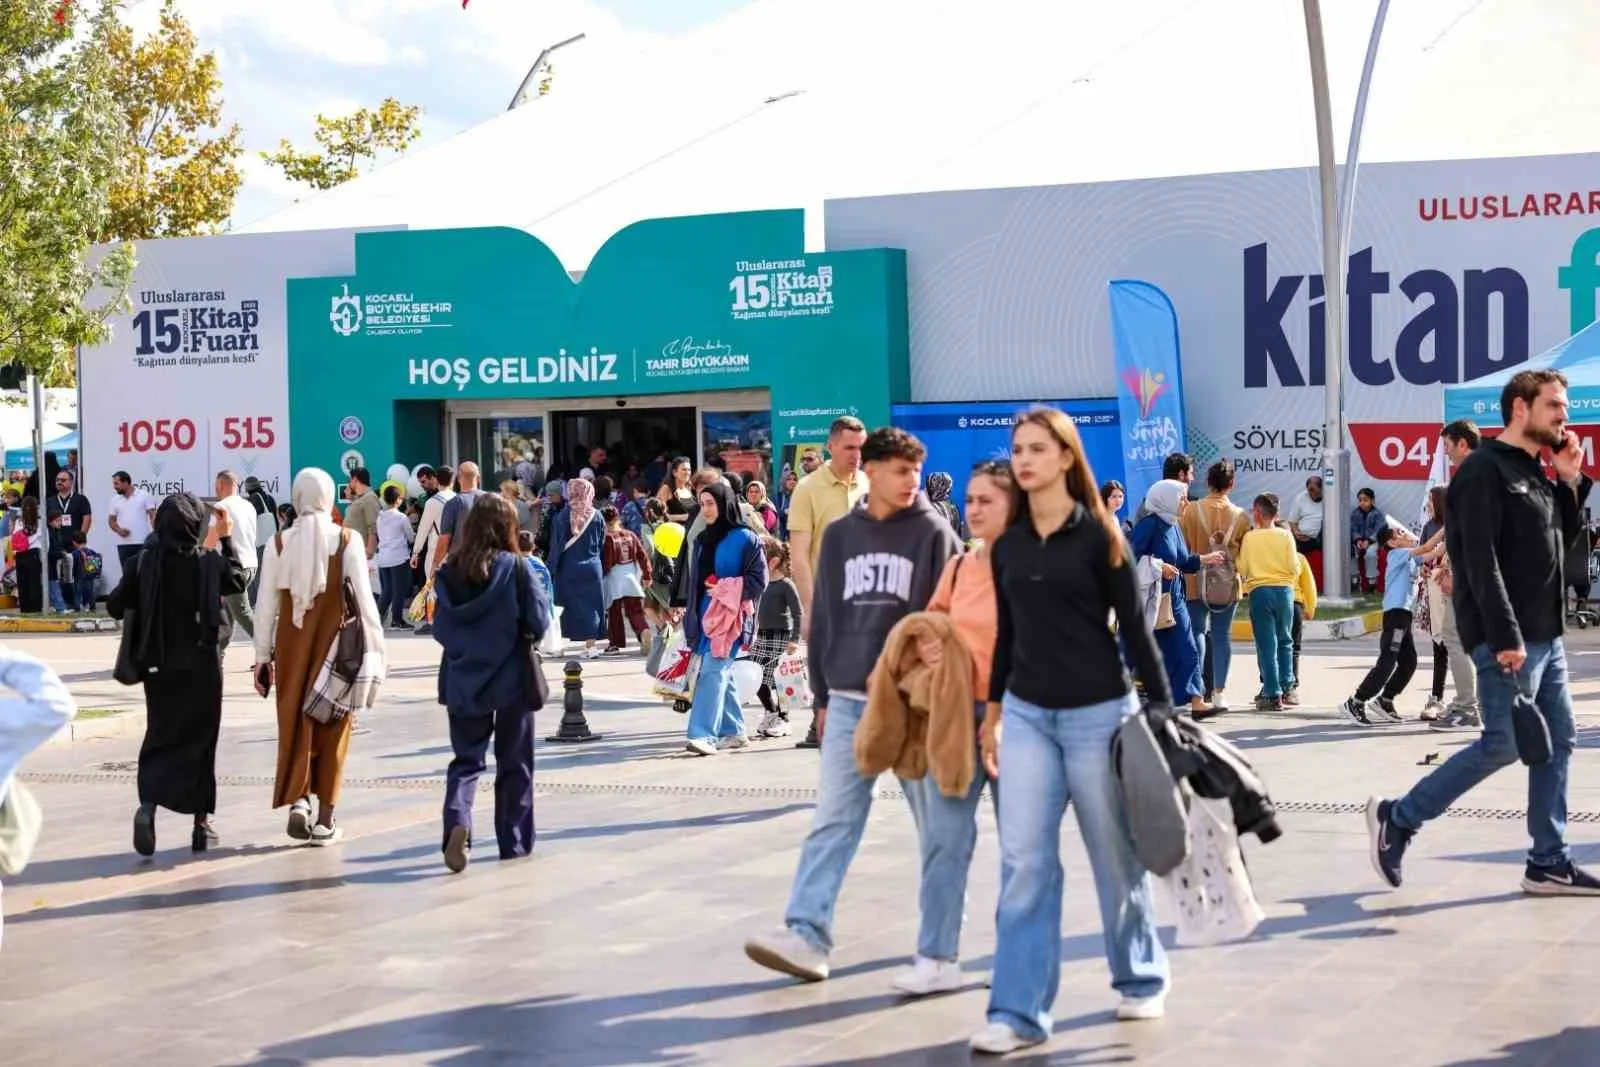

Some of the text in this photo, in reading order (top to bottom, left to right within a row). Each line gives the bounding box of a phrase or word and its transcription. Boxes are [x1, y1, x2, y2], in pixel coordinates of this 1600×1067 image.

[776, 271, 834, 295] Kitap
[140, 288, 226, 304] Uluslararası
[776, 290, 835, 308] Fuarı
[189, 307, 259, 333] Kitap
[365, 302, 453, 315] BÜYÜKŞEHİR
[365, 313, 432, 325] BELEDİYESİ
[190, 330, 260, 353] Fuarı
[408, 347, 618, 392] HOŞ GELDİNİZ
[118, 416, 275, 454] 1050 515
[1233, 425, 1328, 454] SÖYLEŞİ
[842, 552, 914, 602] BOSTON
